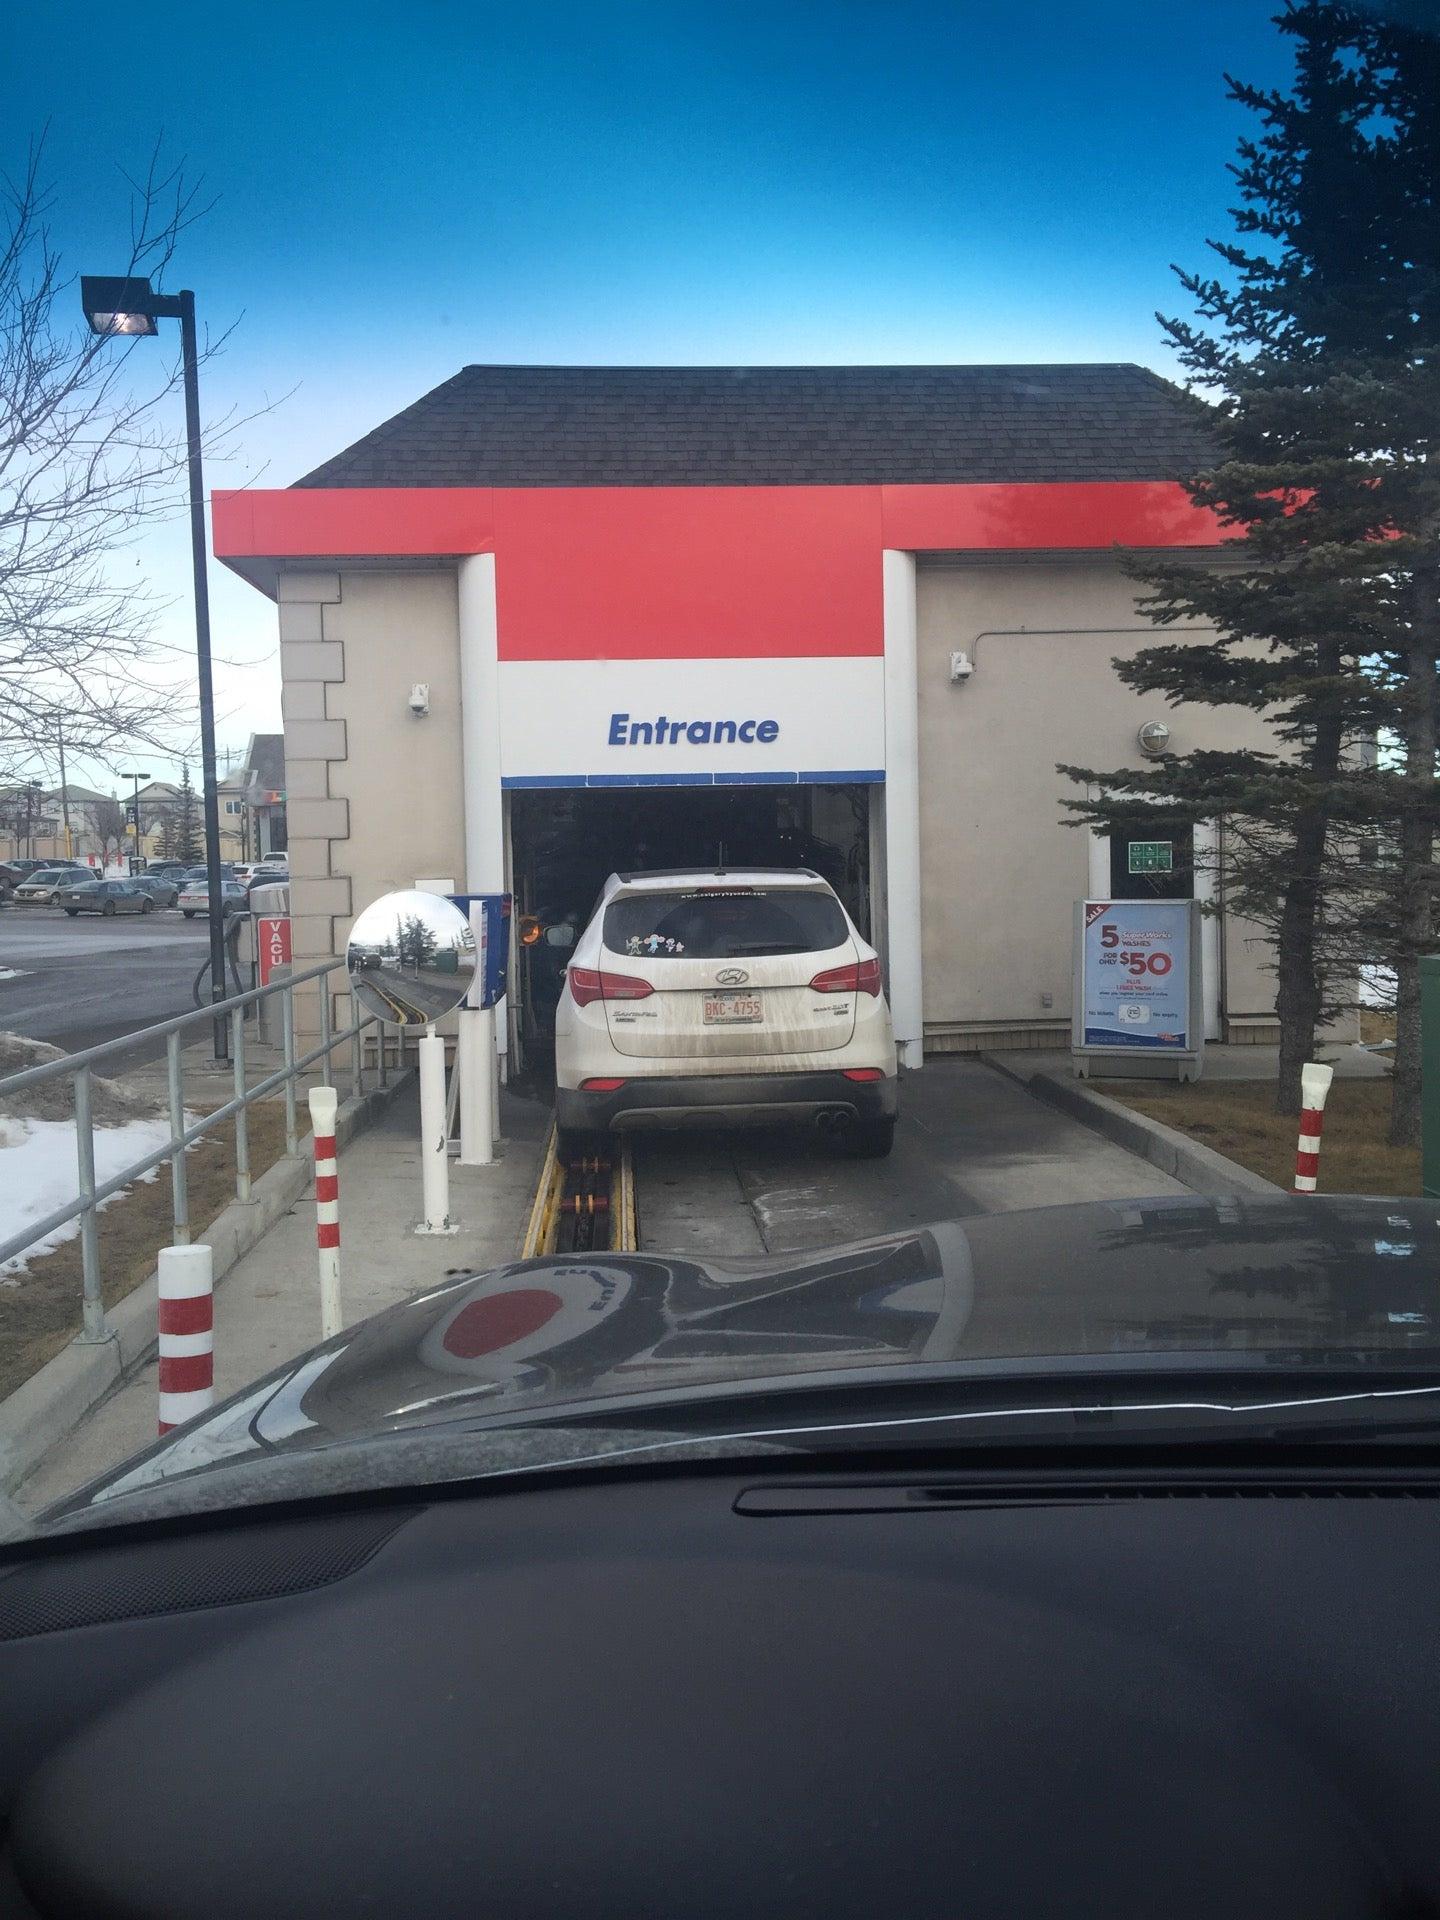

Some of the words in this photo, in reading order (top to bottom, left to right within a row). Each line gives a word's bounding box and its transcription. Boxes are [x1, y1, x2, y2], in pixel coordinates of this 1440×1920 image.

[608, 713, 780, 745] Entrance
[1086, 906, 1104, 923] SALE
[270, 921, 283, 968] VACU
[1100, 925, 1119, 948] 5
